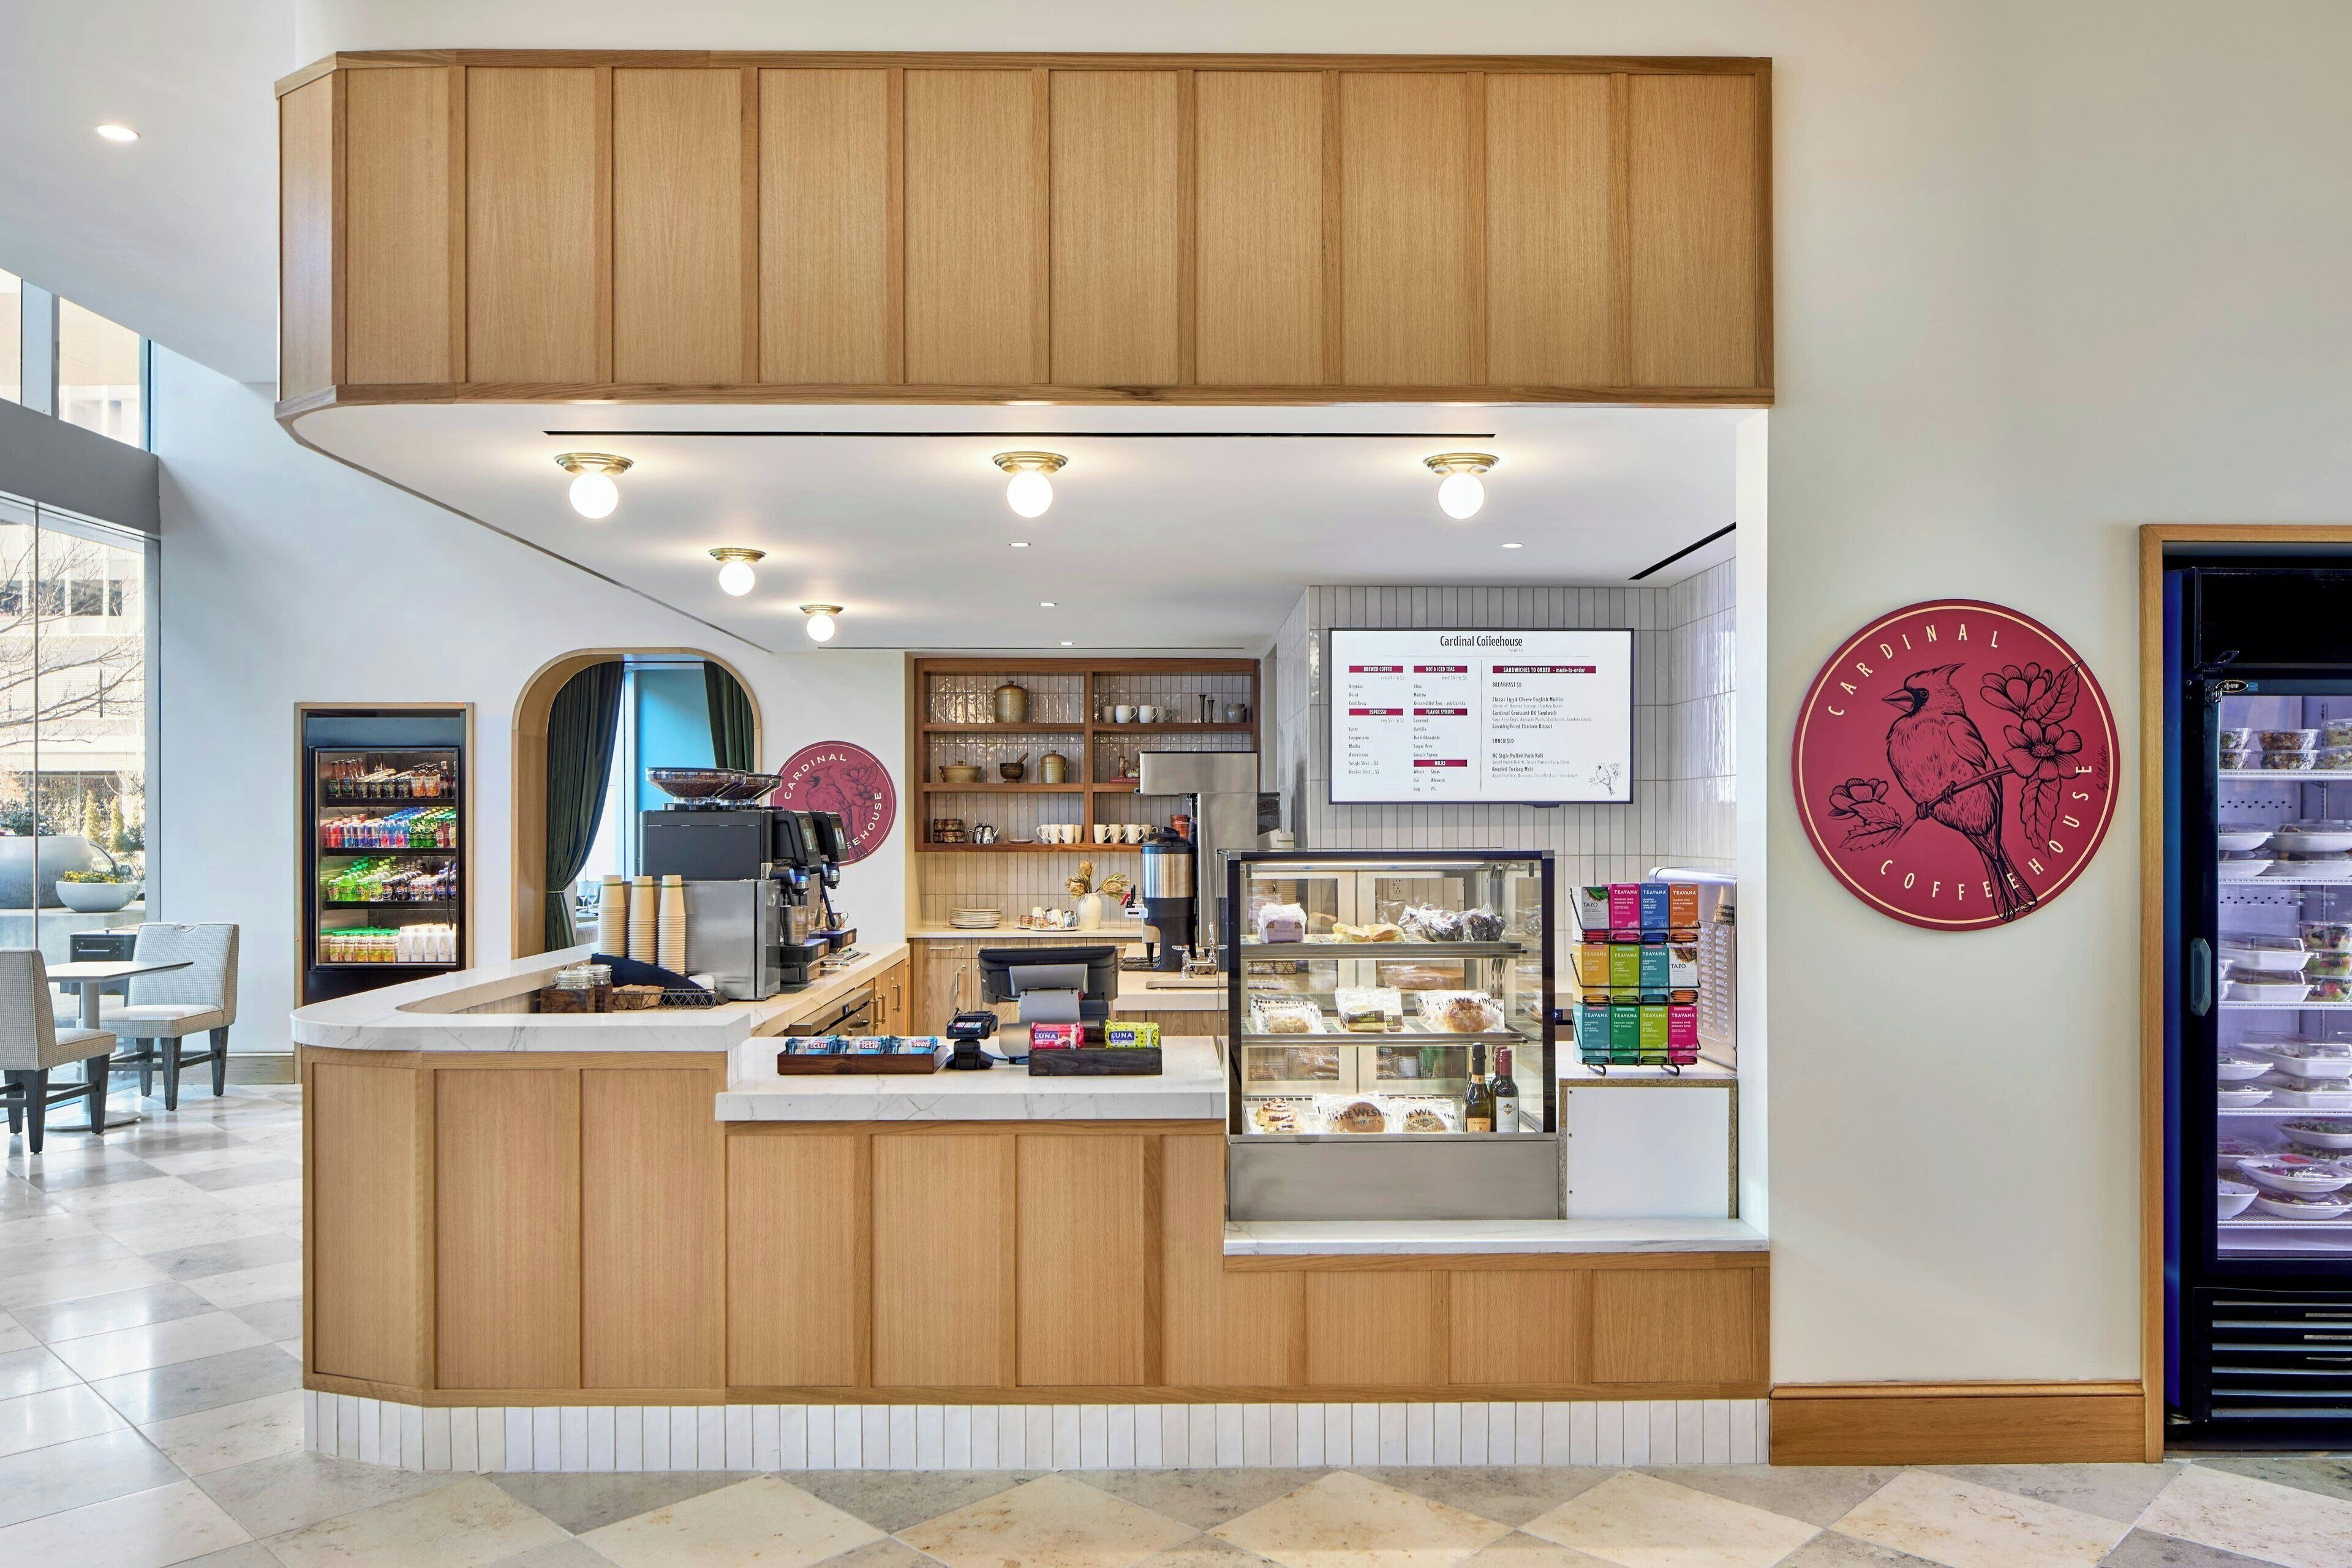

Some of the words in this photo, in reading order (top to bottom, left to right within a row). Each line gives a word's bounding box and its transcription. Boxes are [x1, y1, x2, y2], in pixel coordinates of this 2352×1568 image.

[1440, 636, 1474, 646] Cardinal
[1477, 636, 1523, 646] Coffeehouse
[1828, 624, 2000, 717] CARDINAL
[784, 753, 847, 800] CARDINAL
[846, 792, 881, 849] EHOUSE
[1880, 765, 2093, 900] COFFEEHOUSE
